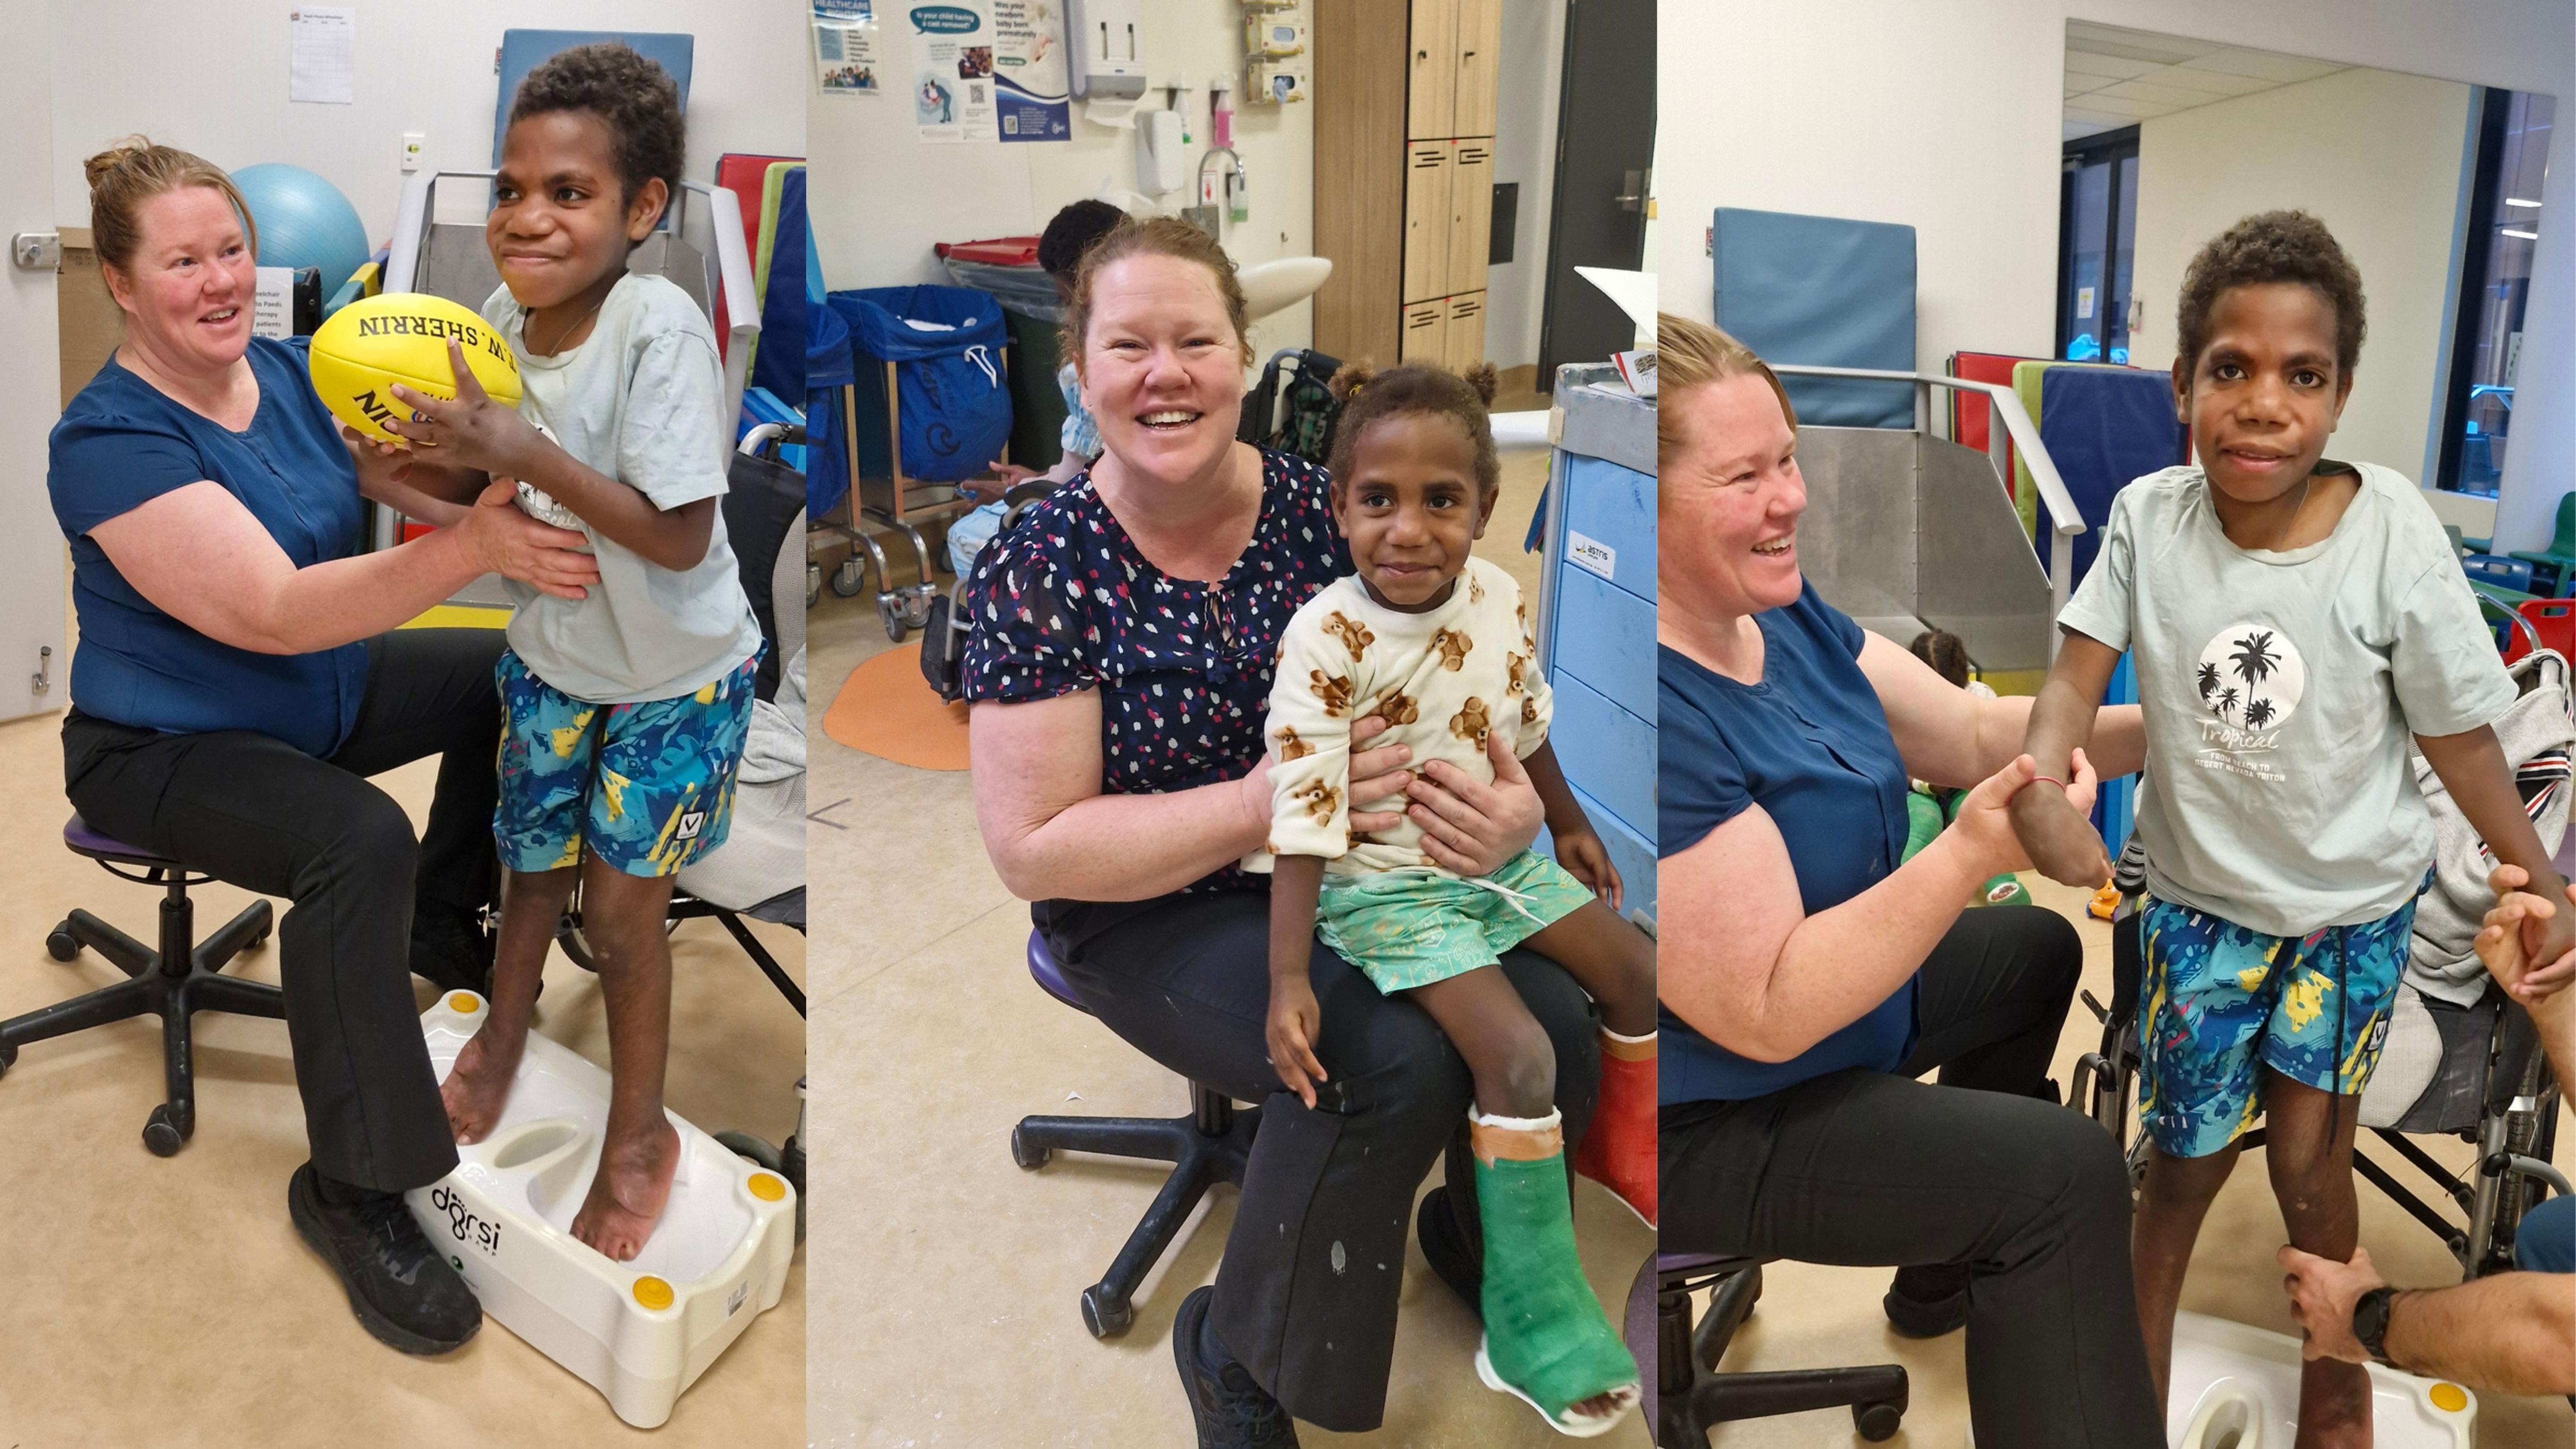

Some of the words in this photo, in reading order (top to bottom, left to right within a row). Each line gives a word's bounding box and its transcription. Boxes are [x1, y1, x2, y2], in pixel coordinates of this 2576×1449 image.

[2195, 718, 2280, 749] Tropical
[2211, 752, 2231, 763] FROM
[2195, 759, 2224, 769] DESERT
[2226, 765, 2254, 778] NEVADA
